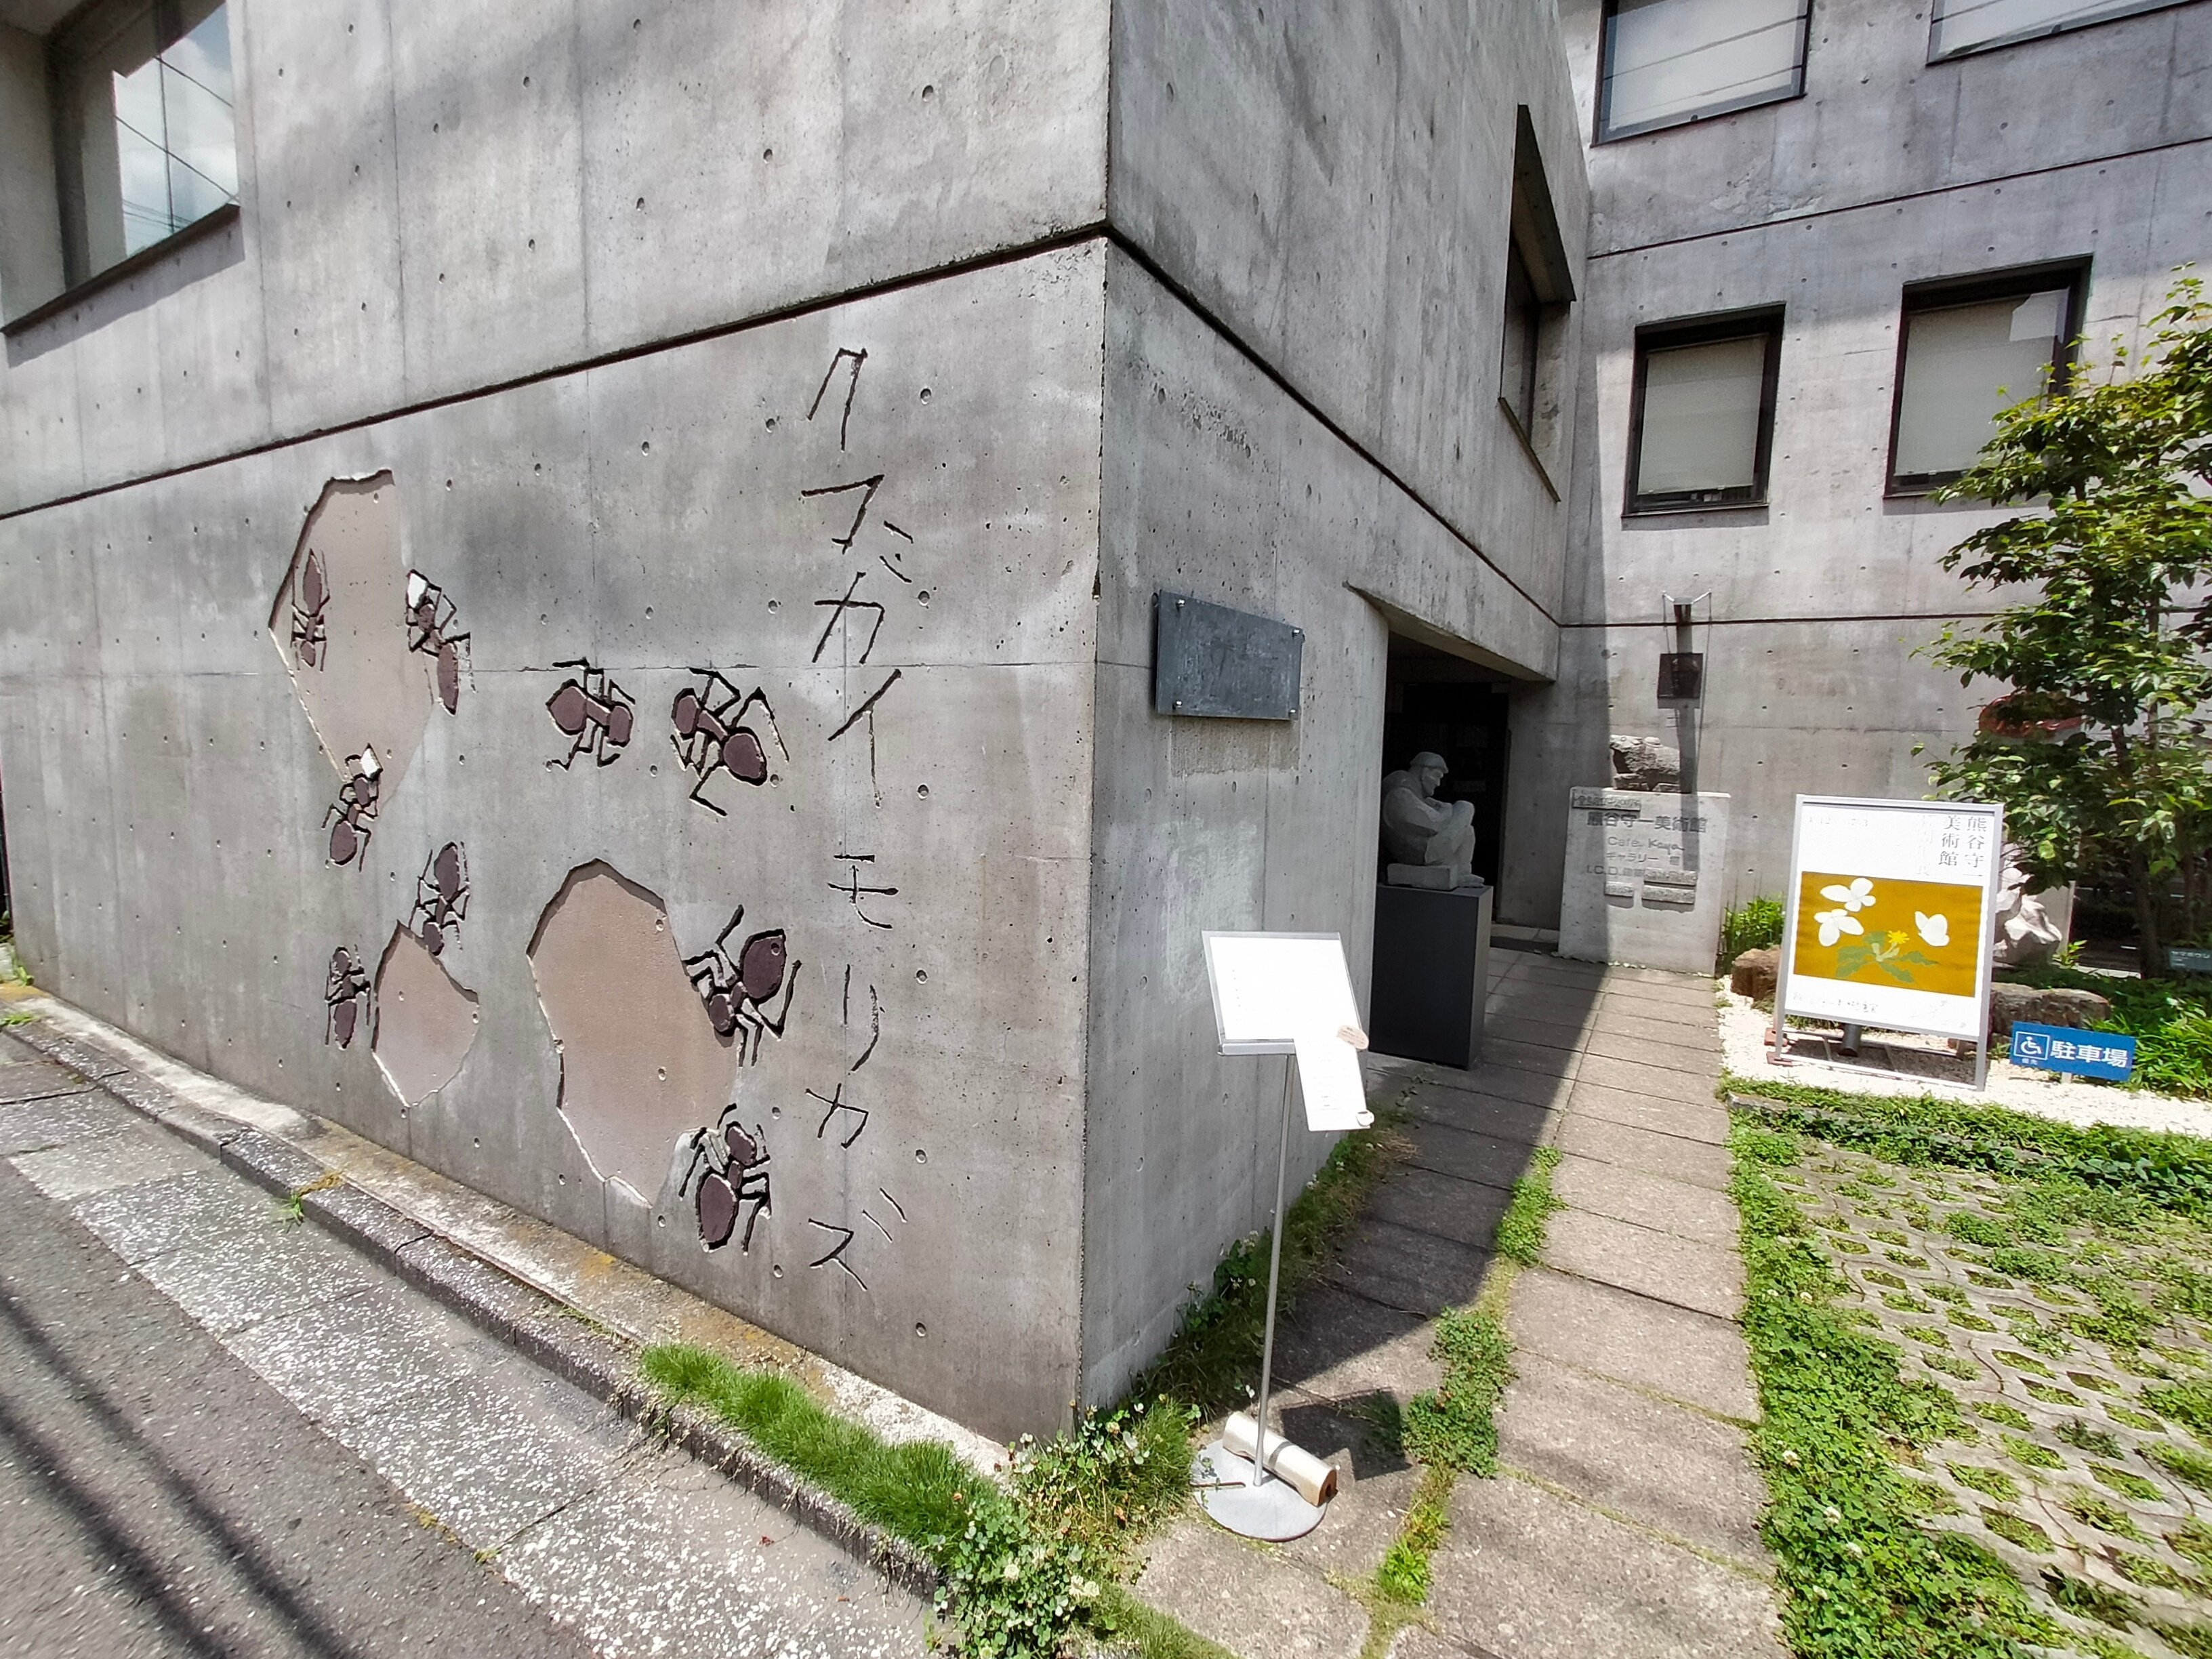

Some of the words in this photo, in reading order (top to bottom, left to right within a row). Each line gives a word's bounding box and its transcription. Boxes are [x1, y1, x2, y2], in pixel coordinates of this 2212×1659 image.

[1938, 815, 1962, 867] 美術館
[1962, 816, 1988, 878] 熊谷守一
[2050, 1040, 2129, 1068] 駐車場
